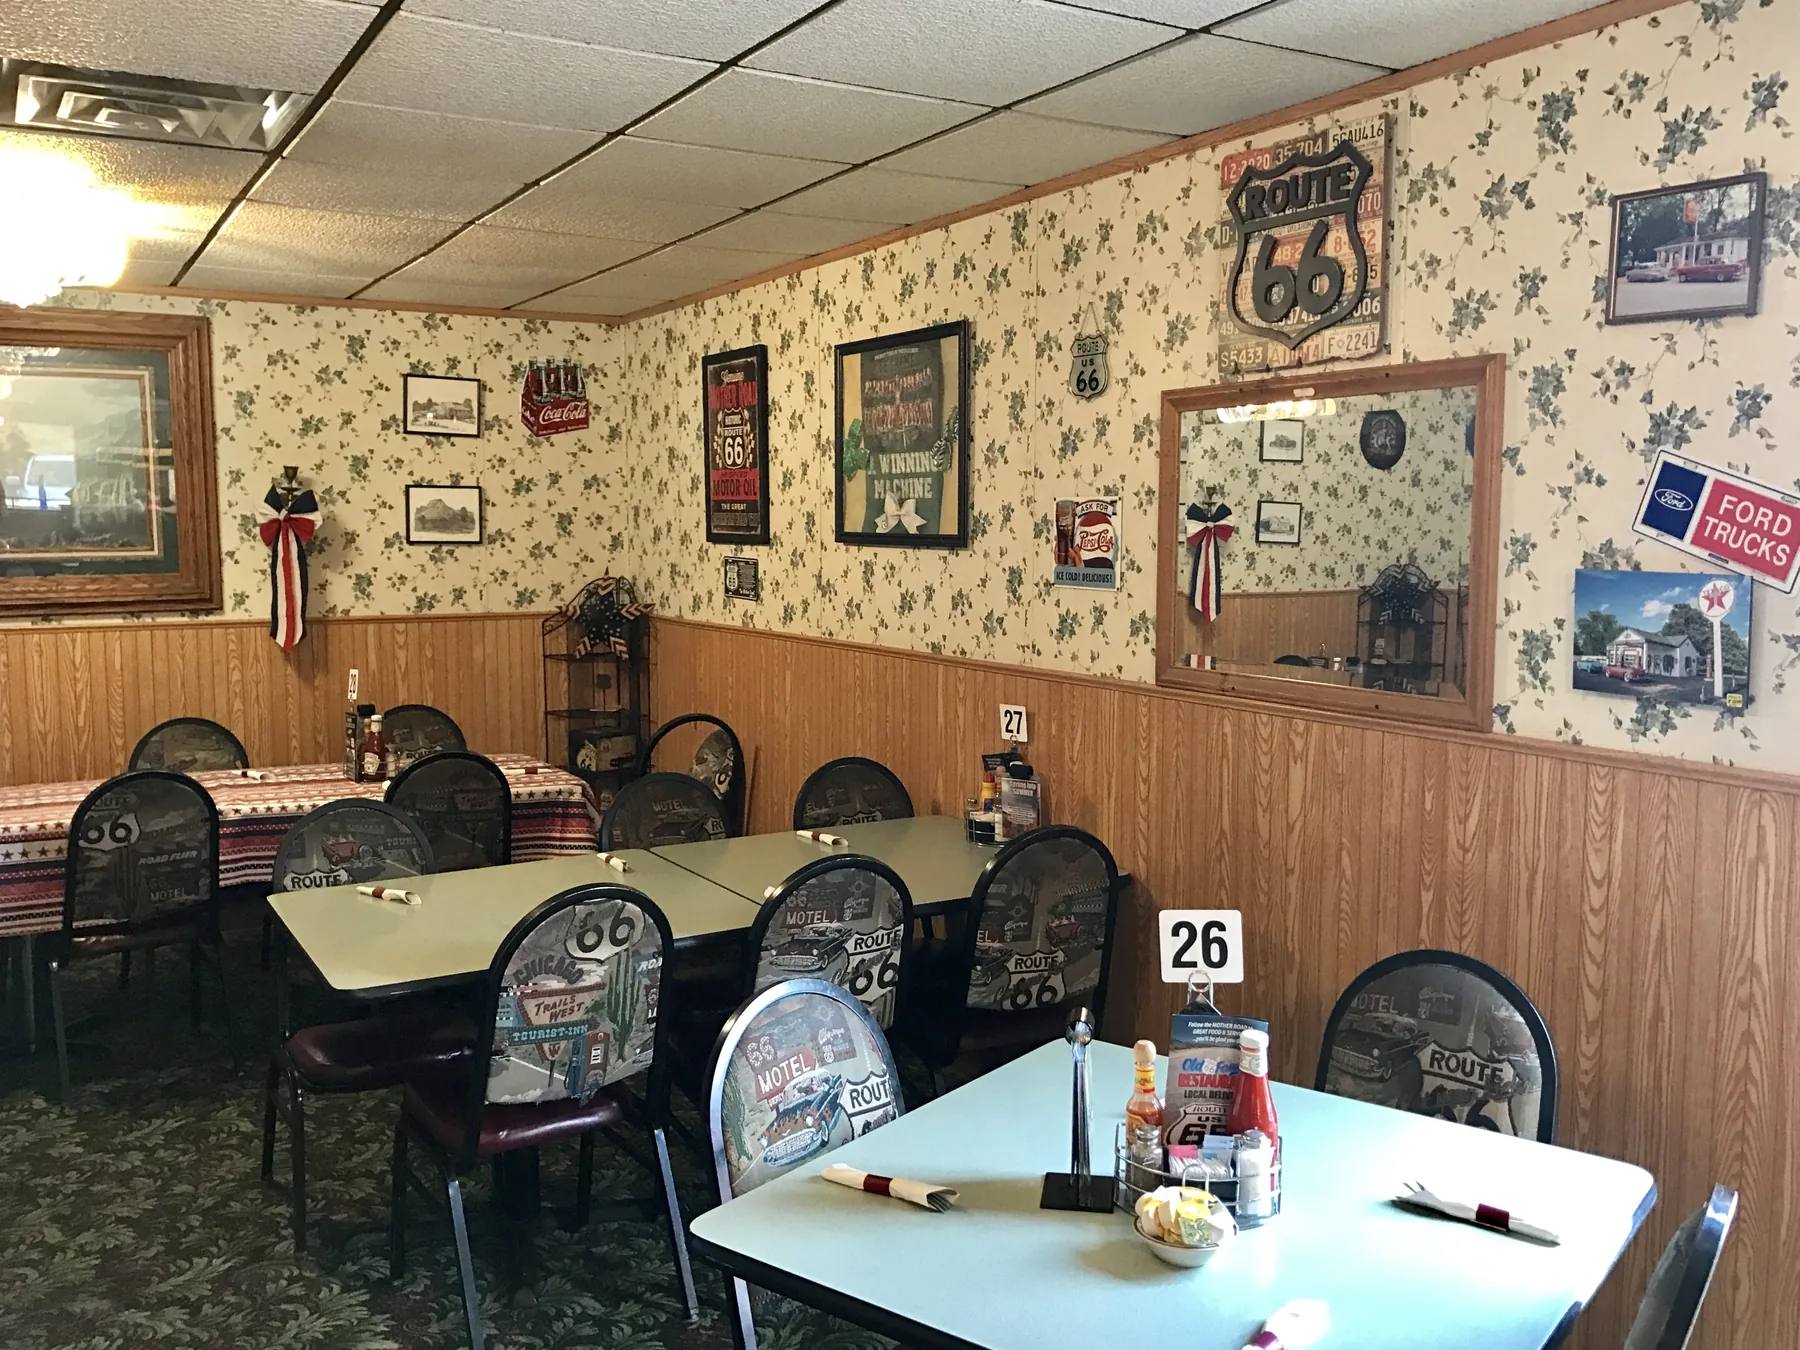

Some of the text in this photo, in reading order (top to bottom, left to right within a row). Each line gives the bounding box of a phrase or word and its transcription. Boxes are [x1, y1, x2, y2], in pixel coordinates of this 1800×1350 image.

[1243, 163, 1353, 221] ROUTE
[1252, 219, 1344, 323] 66
[1077, 341, 1099, 354] ROUTE
[1076, 368, 1099, 392] 66
[725, 437, 743, 465] 66
[713, 478, 757, 496] MOTOR OIL
[874, 478, 932, 499] MACHINE
[1080, 503, 1109, 513] ASK FOR
[1660, 491, 1686, 509] Ford
[1718, 494, 1792, 537] FORD
[1704, 516, 1790, 567] TRUCKS
[1056, 571, 1064, 580] ICE
[1004, 709, 1023, 735] 27
[291, 874, 342, 889] ROUTE
[151, 887, 186, 902] MOTEL
[786, 909, 830, 925] MOTEL
[576, 904, 636, 953] 66
[1171, 920, 1228, 969] 26
[534, 995, 576, 1016] TRAILS
[549, 1002, 585, 1023] WEST
[757, 1053, 811, 1095] MOTEL
[1182, 1058, 1203, 1072] Old
[1184, 1090, 1207, 1099] LOCAL
